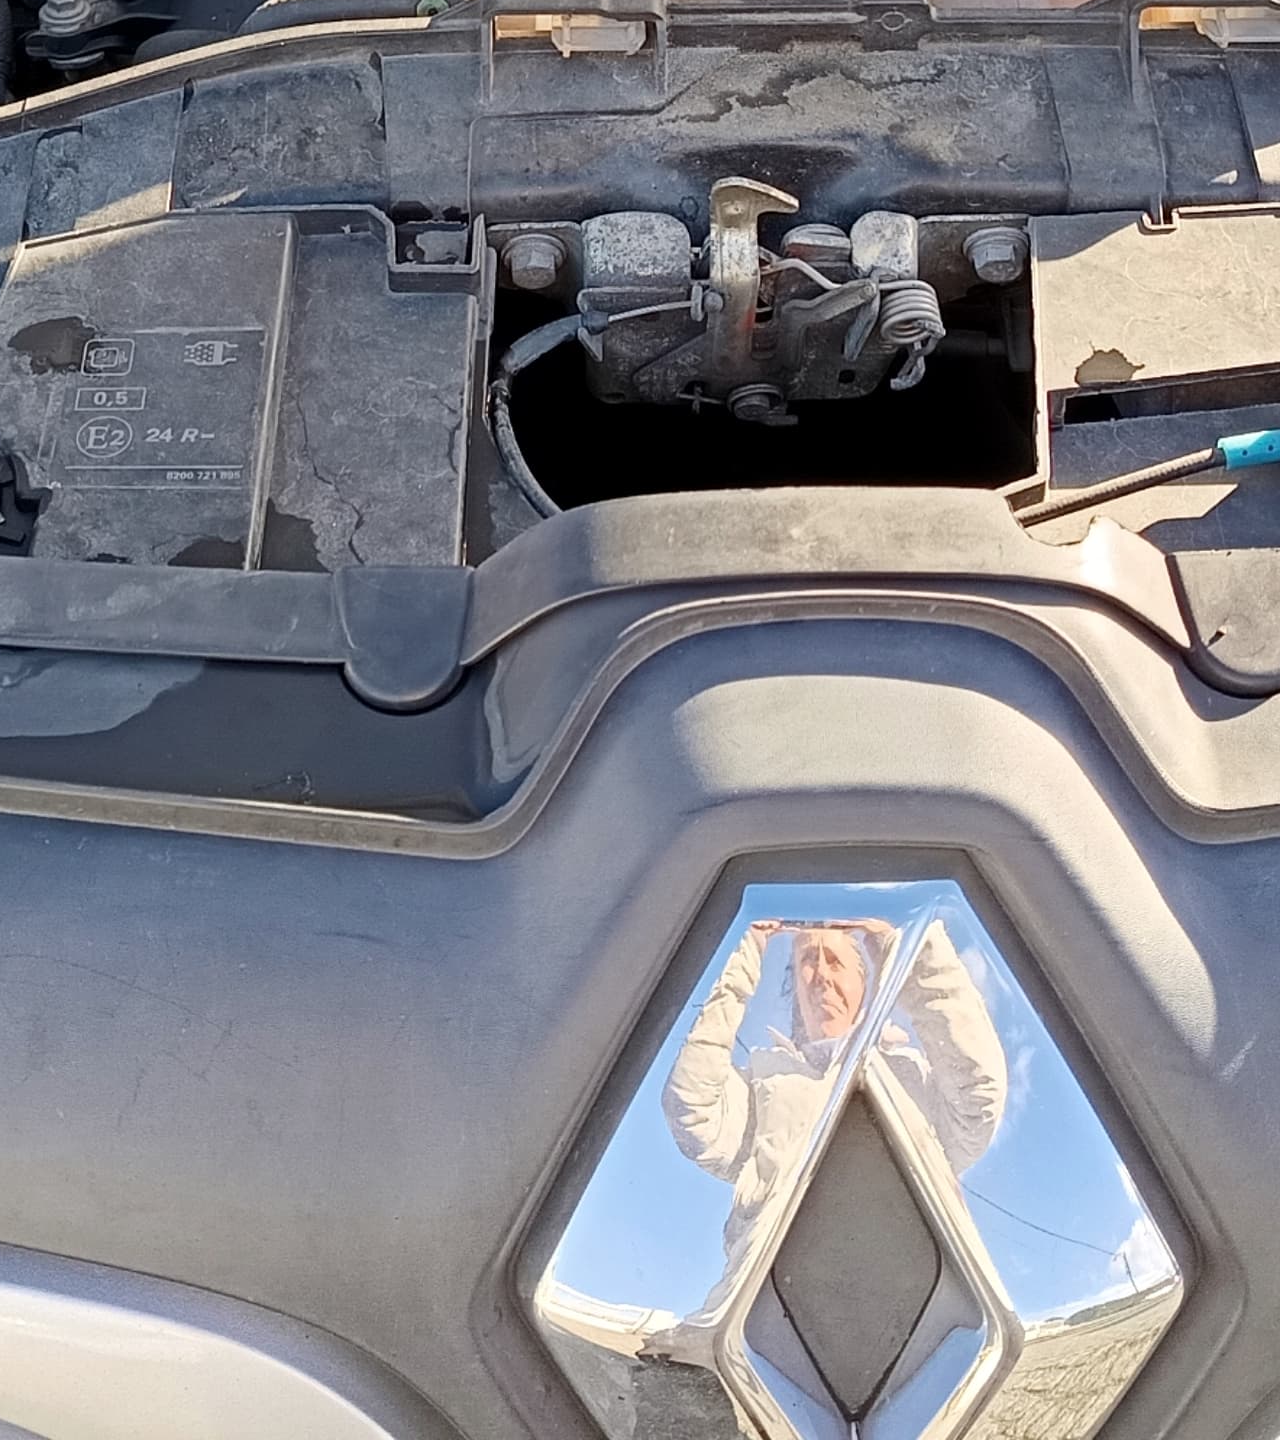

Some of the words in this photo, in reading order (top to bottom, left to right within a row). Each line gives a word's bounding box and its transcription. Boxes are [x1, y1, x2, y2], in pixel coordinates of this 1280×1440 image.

[94, 391, 128, 406] 0,5
[85, 425, 125, 449] E2
[145, 428, 173, 442] 24
